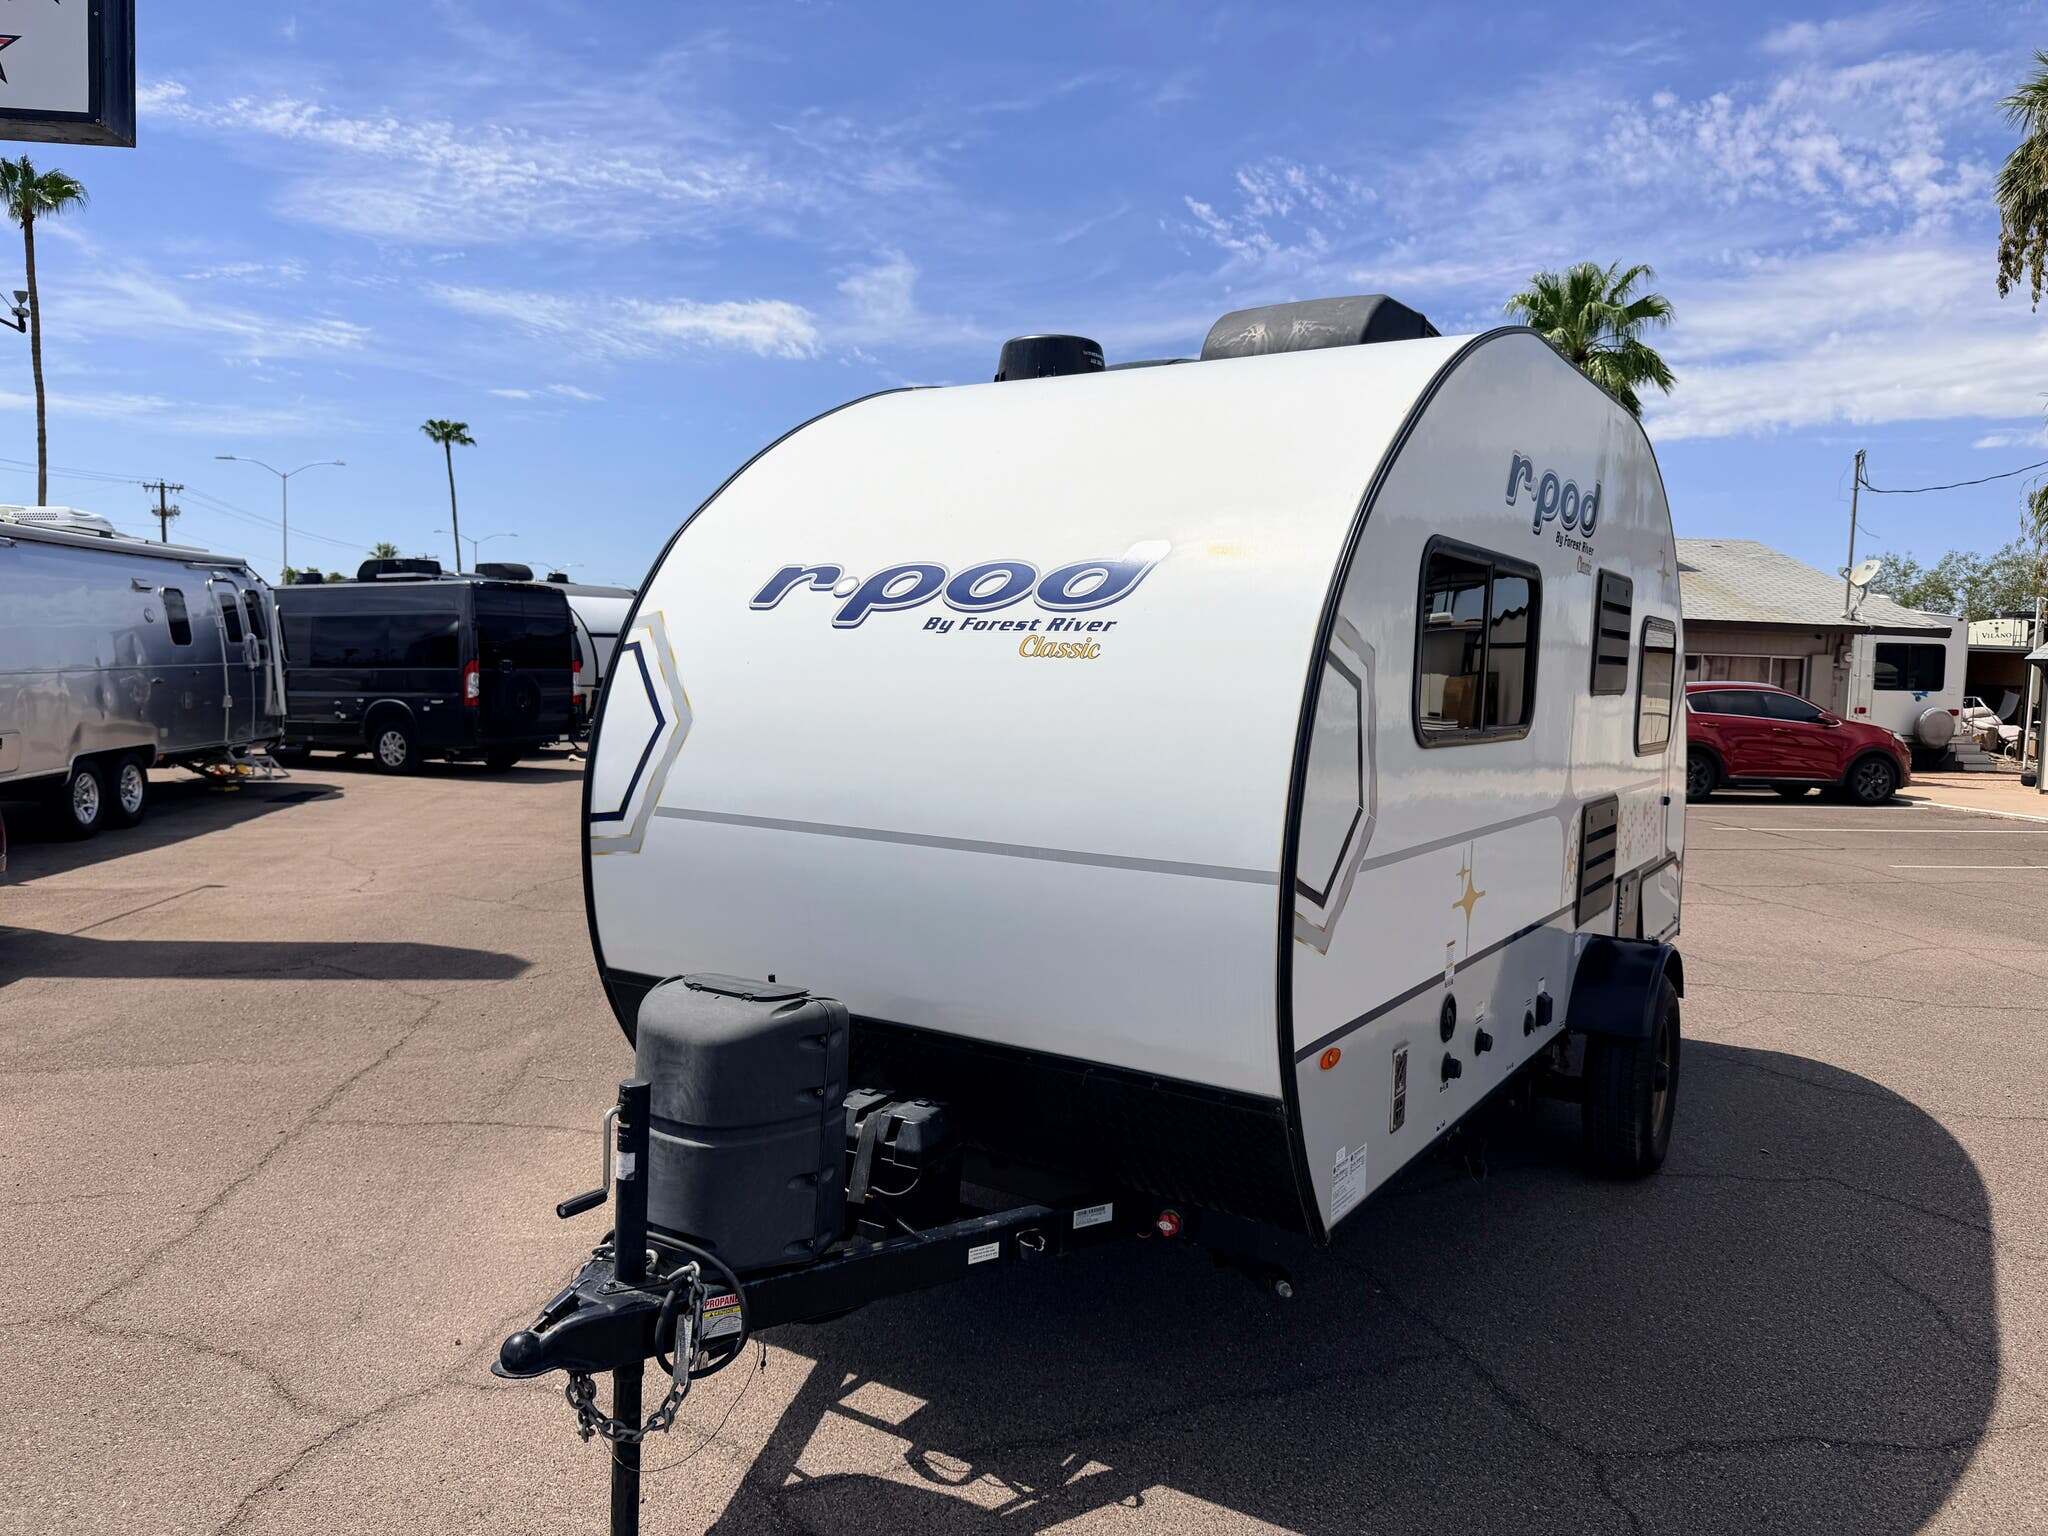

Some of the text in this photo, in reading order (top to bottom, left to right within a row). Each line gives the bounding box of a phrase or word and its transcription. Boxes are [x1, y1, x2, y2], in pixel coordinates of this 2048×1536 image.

[1555, 531, 1594, 556] By Forest River
[922, 616, 1118, 634] By Forest River
[1018, 634, 1101, 660] Classic
